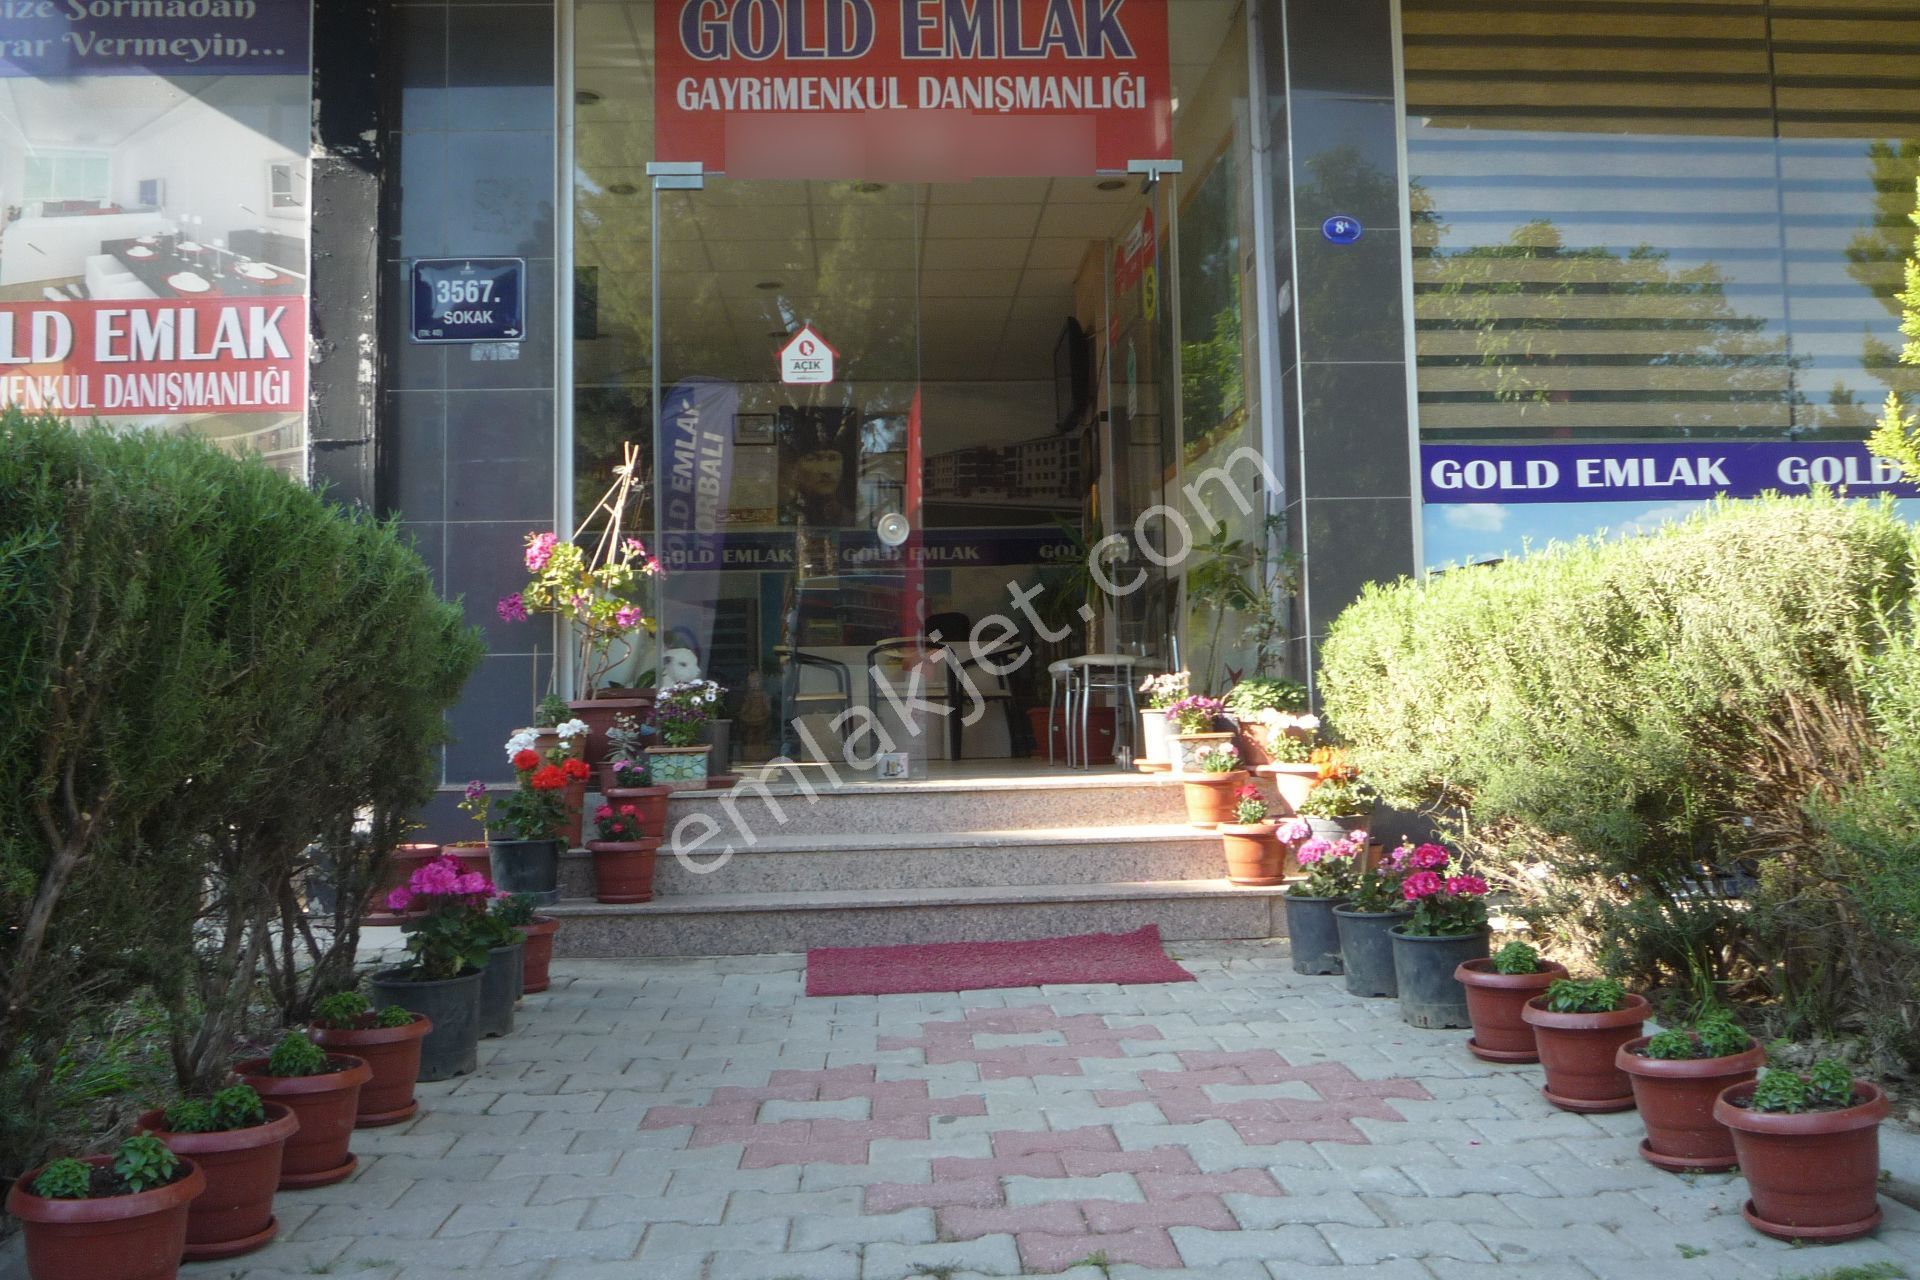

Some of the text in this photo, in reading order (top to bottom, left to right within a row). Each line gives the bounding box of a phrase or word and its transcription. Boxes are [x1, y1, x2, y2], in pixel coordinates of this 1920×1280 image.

[679, 0, 1137, 60] GOLD EMLAK
[918, 72, 1145, 112] DANIŞMANLIĞI
[437, 280, 500, 303] 3567.
[443, 311, 493, 324] SOKAK
[95, 306, 290, 362] EMLAK
[793, 361, 820, 372] AÇIK
[104, 367, 290, 410] DANIŞMANLIĞI
[1430, 456, 1901, 489] GOLD EMLAK GOLD
[723, 549, 793, 563] EMLAK
[909, 546, 980, 561] EMLAK
